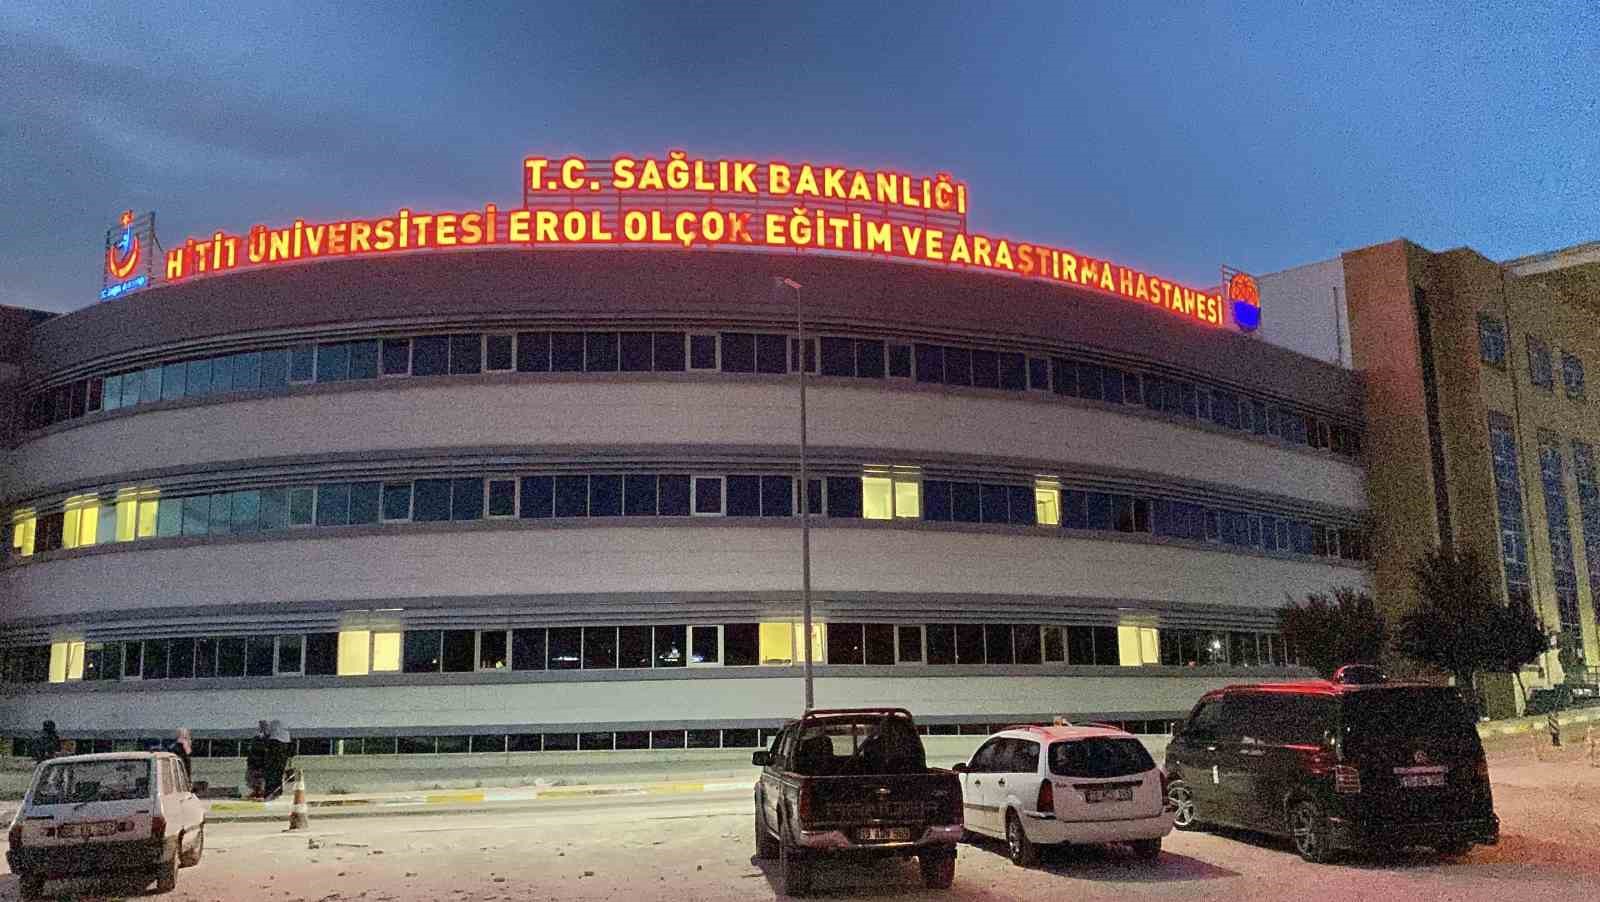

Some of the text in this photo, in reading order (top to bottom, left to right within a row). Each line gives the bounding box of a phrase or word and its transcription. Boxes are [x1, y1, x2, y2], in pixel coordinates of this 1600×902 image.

[525, 151, 966, 214] T.C. SAĞLIK BAKANLIĞI
[248, 205, 496, 264] ÜNİVERSİTESİ
[509, 211, 612, 242] EROL
[623, 211, 753, 248] OLÇOK
[765, 207, 892, 253] EĞİTİM
[902, 225, 944, 260] VE
[950, 233, 1115, 292] ARAŞTIRMA
[1119, 267, 1223, 325] HASTANESİ
